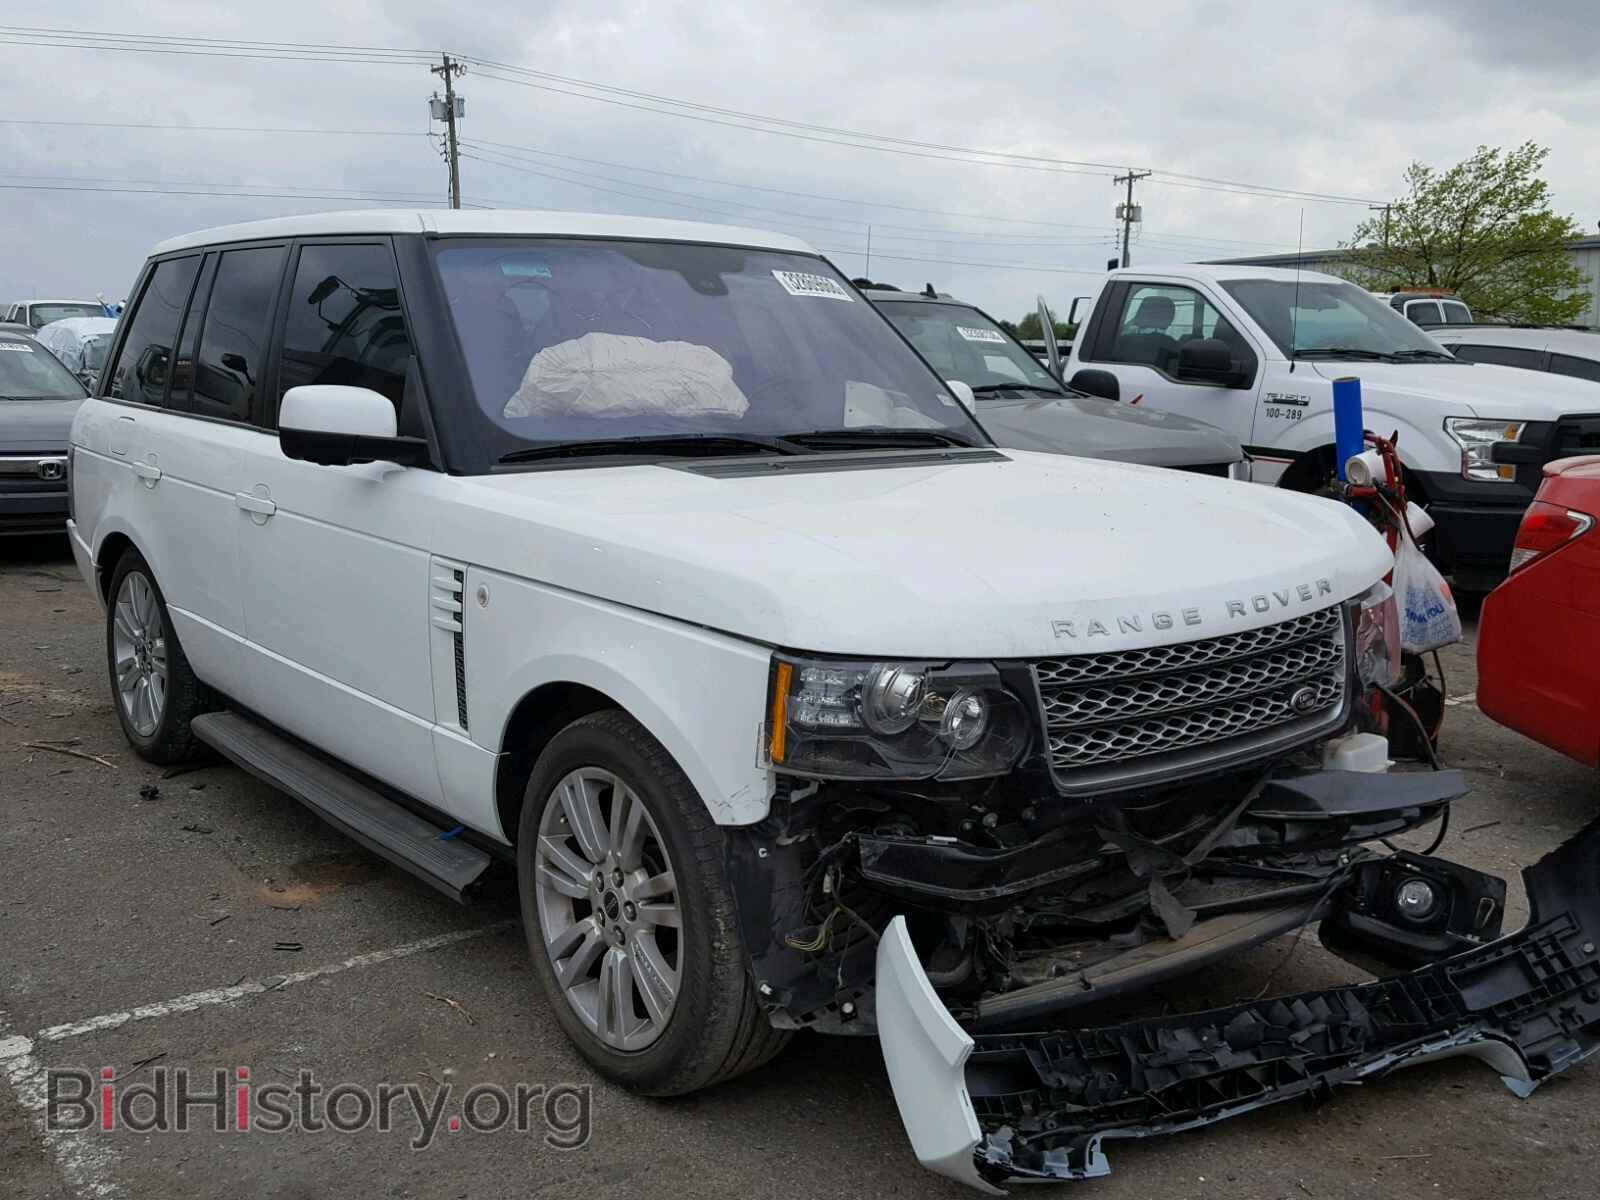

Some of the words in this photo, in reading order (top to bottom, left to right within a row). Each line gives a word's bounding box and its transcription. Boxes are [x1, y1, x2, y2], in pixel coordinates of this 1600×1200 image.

[1265, 407, 1303, 420] 100-289
[1050, 607, 1202, 639] RANGE
[1225, 577, 1333, 619] ROVER
